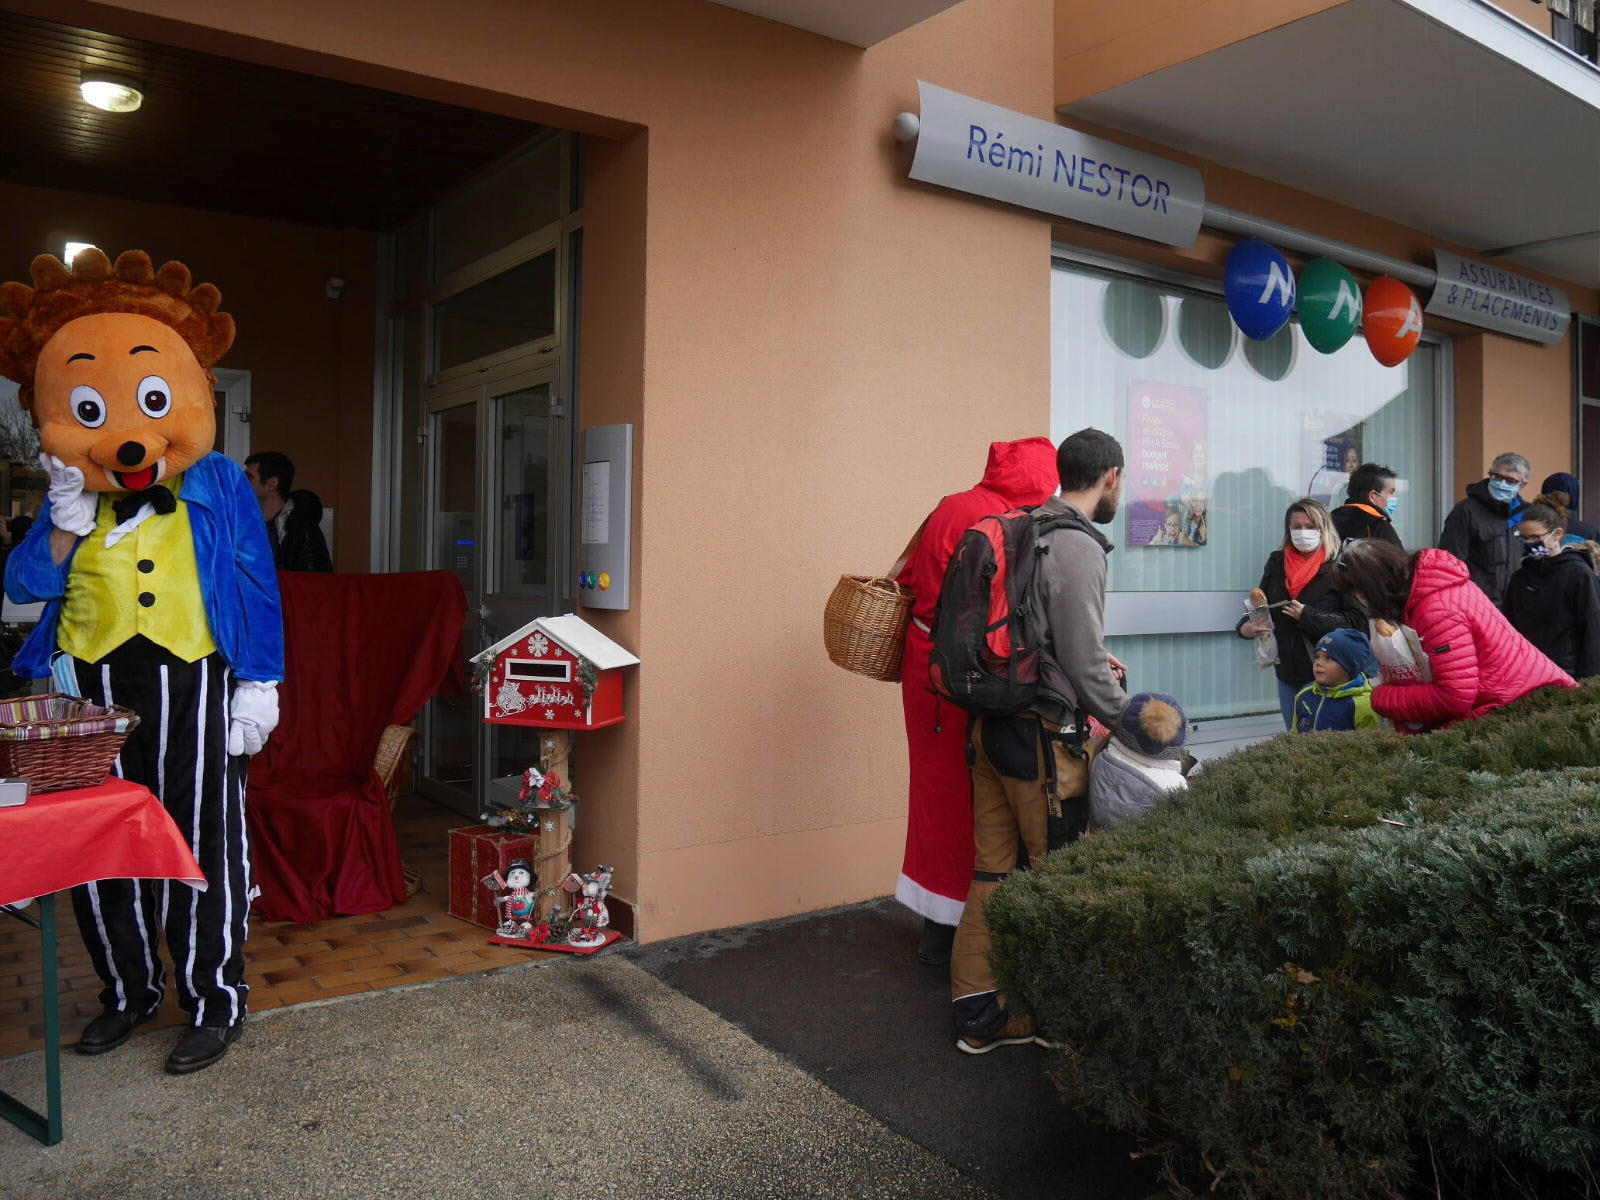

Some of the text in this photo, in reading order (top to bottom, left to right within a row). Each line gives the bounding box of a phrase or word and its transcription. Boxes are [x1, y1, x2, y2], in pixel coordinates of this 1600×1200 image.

[966, 124, 1171, 214] Rémi NESTOR
[1460, 260, 1554, 305] ASSURANCES
[1447, 284, 1559, 331] & PLACEMENTS
